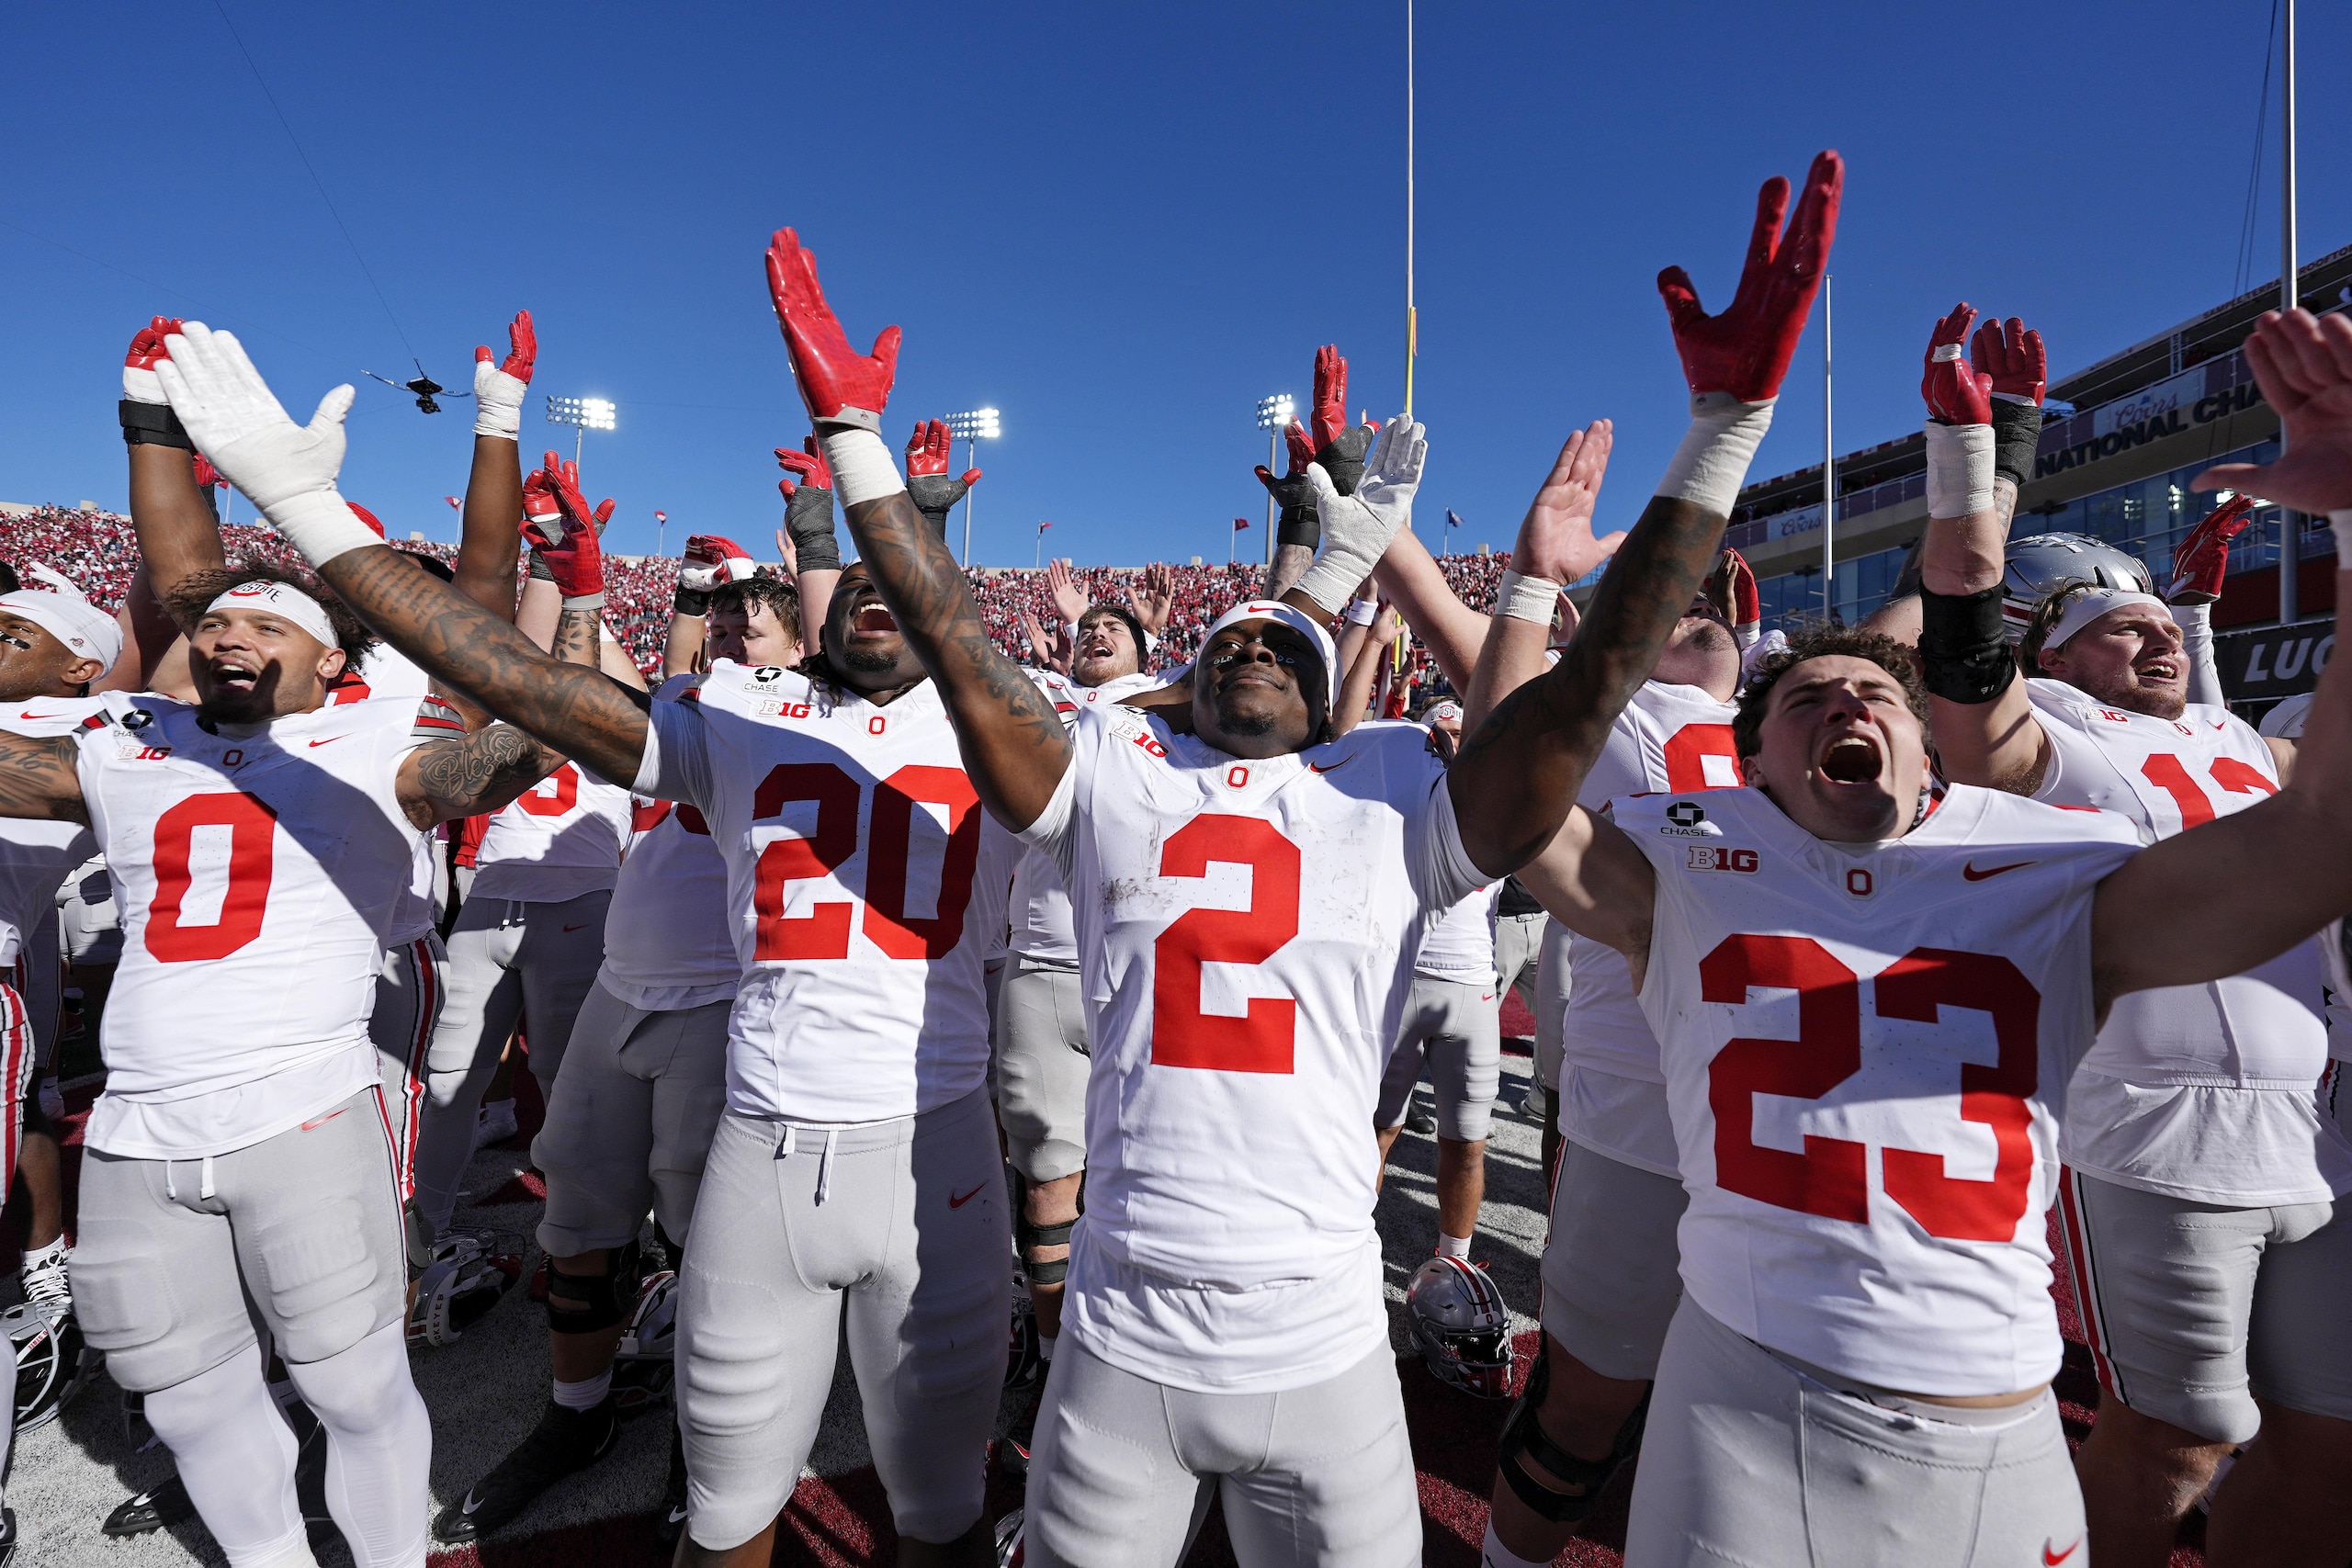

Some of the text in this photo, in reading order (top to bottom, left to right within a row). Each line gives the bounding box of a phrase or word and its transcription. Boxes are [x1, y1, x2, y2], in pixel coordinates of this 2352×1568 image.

[2299, 244, 2352, 275] ROOFTO
[2035, 410, 2188, 479] NATIONAL
[744, 682, 778, 693] CHASE
[113, 729, 148, 739] CHASE
[752, 761, 982, 962] 20
[1660, 827, 1710, 837] CHASE
[144, 791, 277, 964] 0
[1151, 813, 1301, 1075] 2
[1699, 933, 2041, 1242] 23
